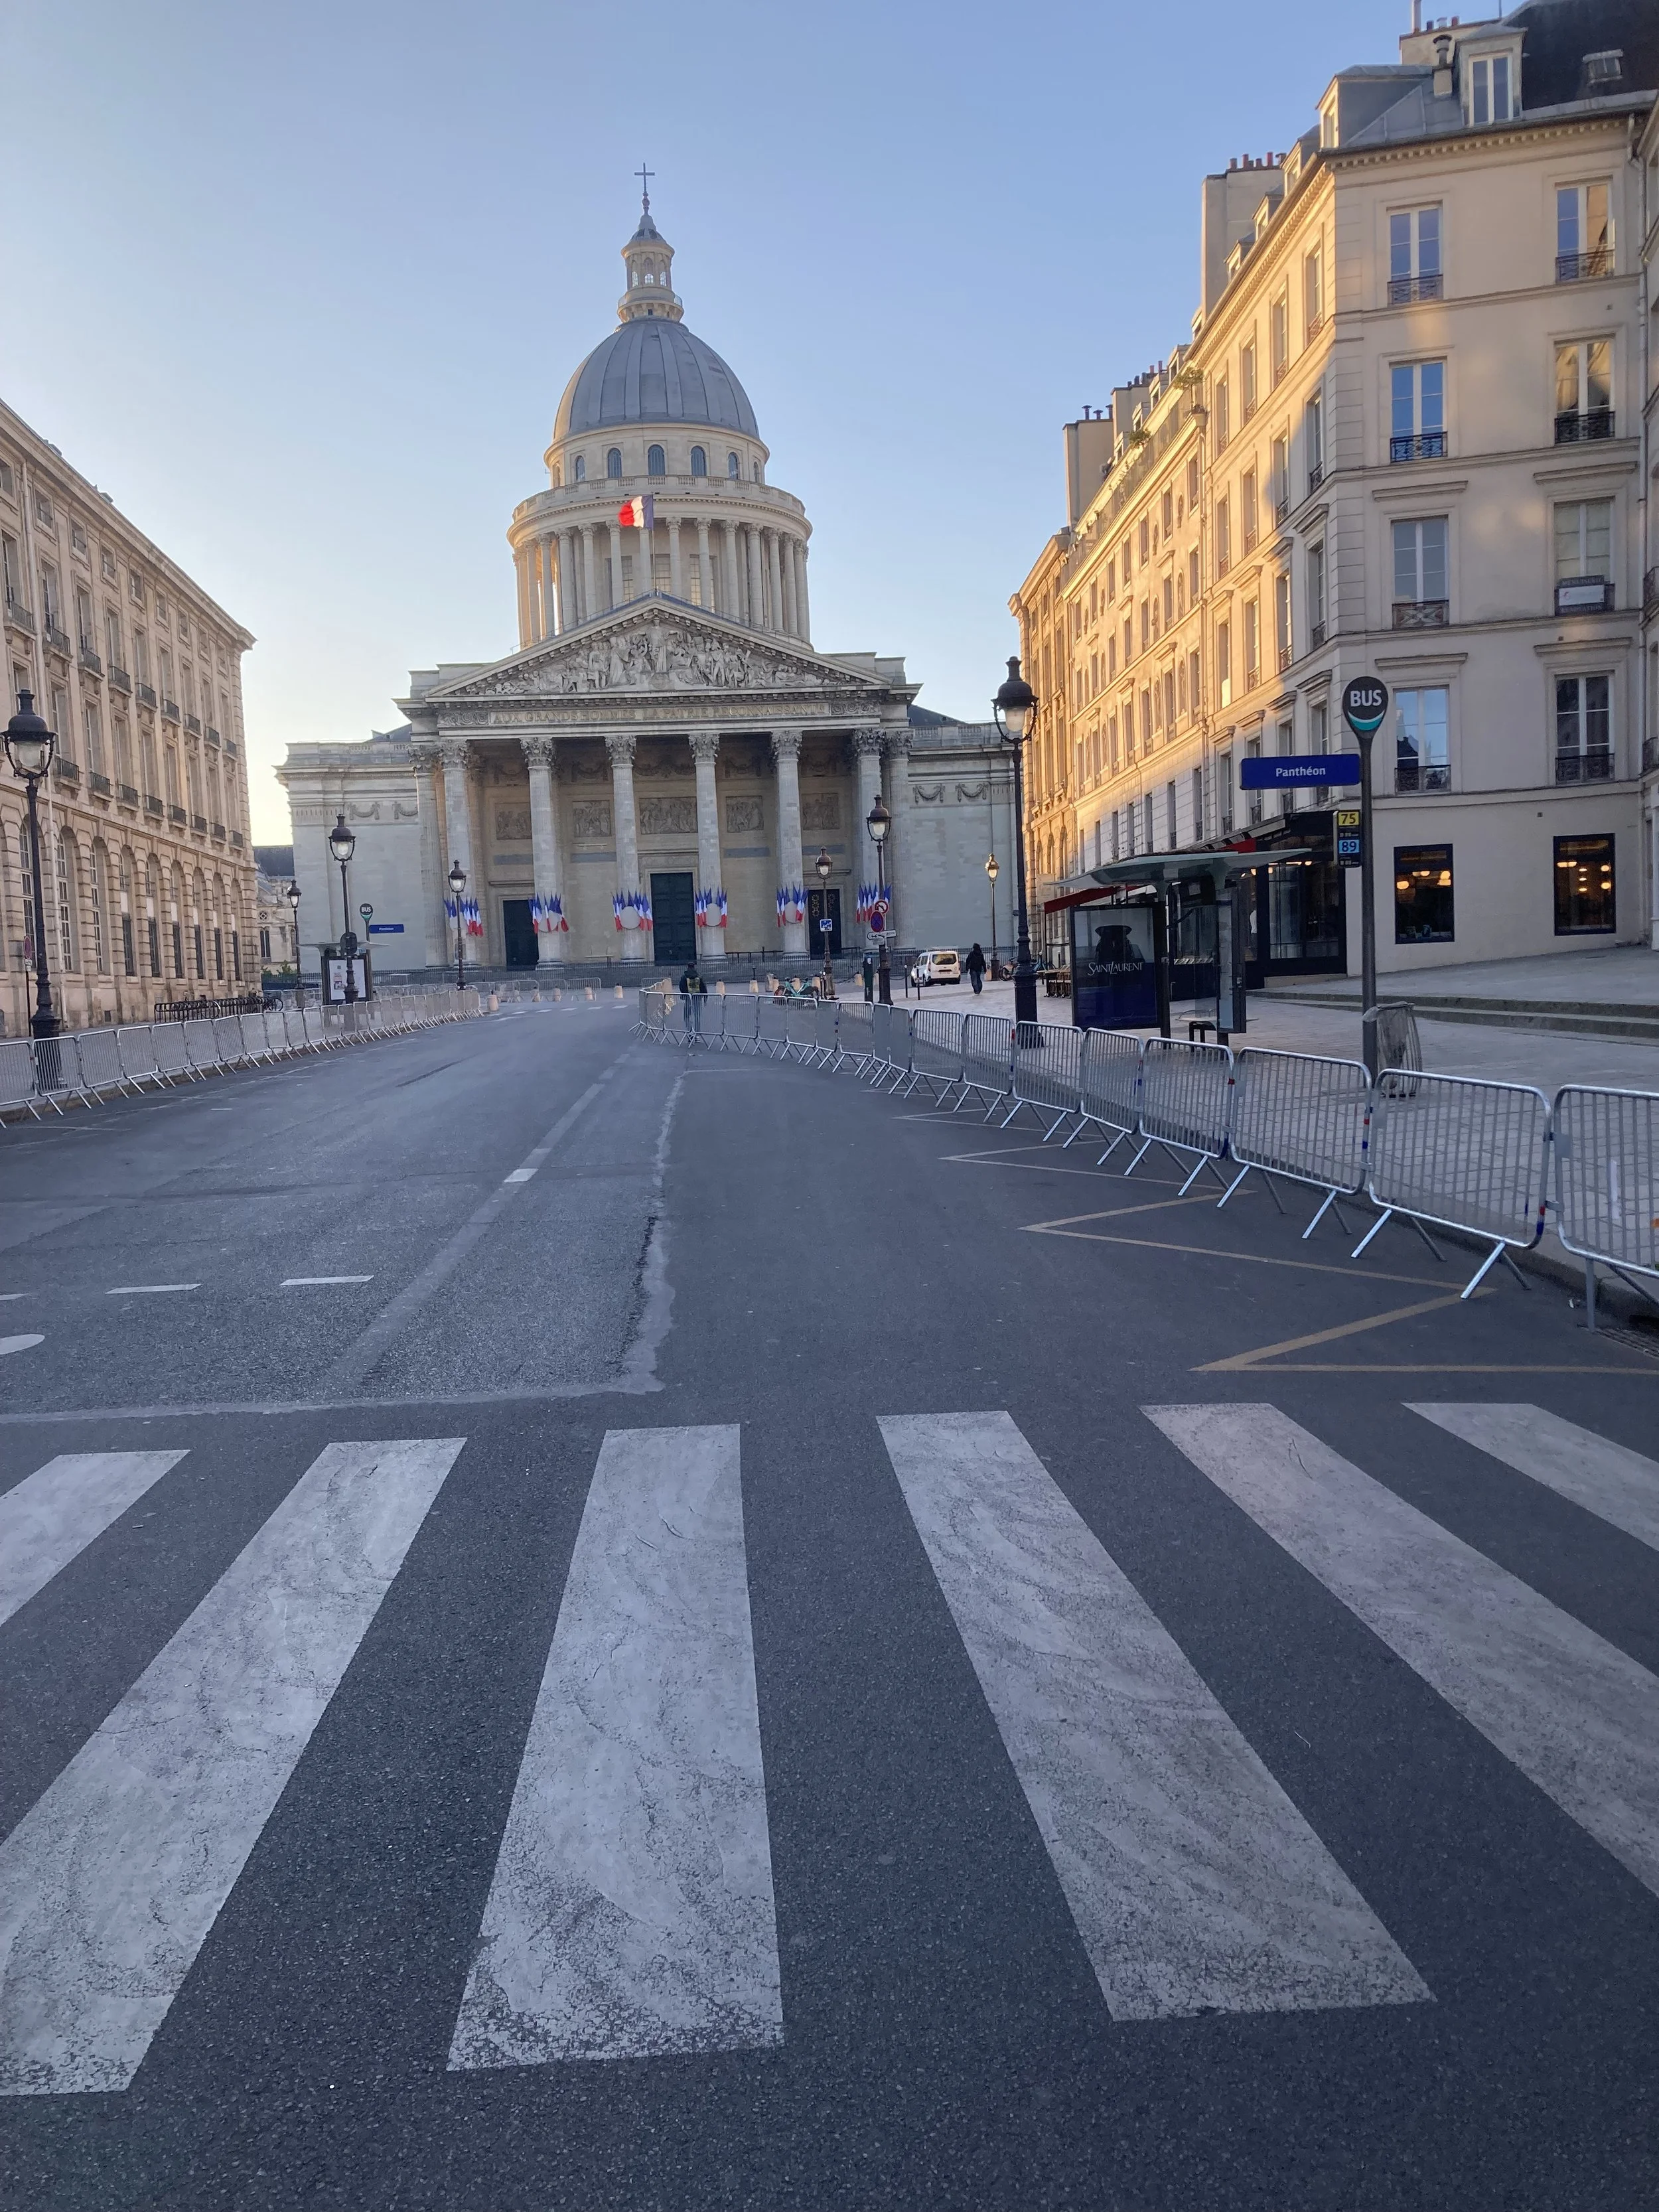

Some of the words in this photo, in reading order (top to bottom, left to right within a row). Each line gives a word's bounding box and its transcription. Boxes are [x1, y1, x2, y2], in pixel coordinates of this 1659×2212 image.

[1350, 690, 1382, 707] BUS
[494, 711, 522, 724] AUX
[524, 710, 578, 723] GRANDS
[580, 709, 636, 721] HOMMES
[661, 707, 708, 718] PATRIE
[1275, 766, 1326, 777] Panthéon
[1340, 813, 1356, 824] 75
[1341, 841, 1356, 852] 89
